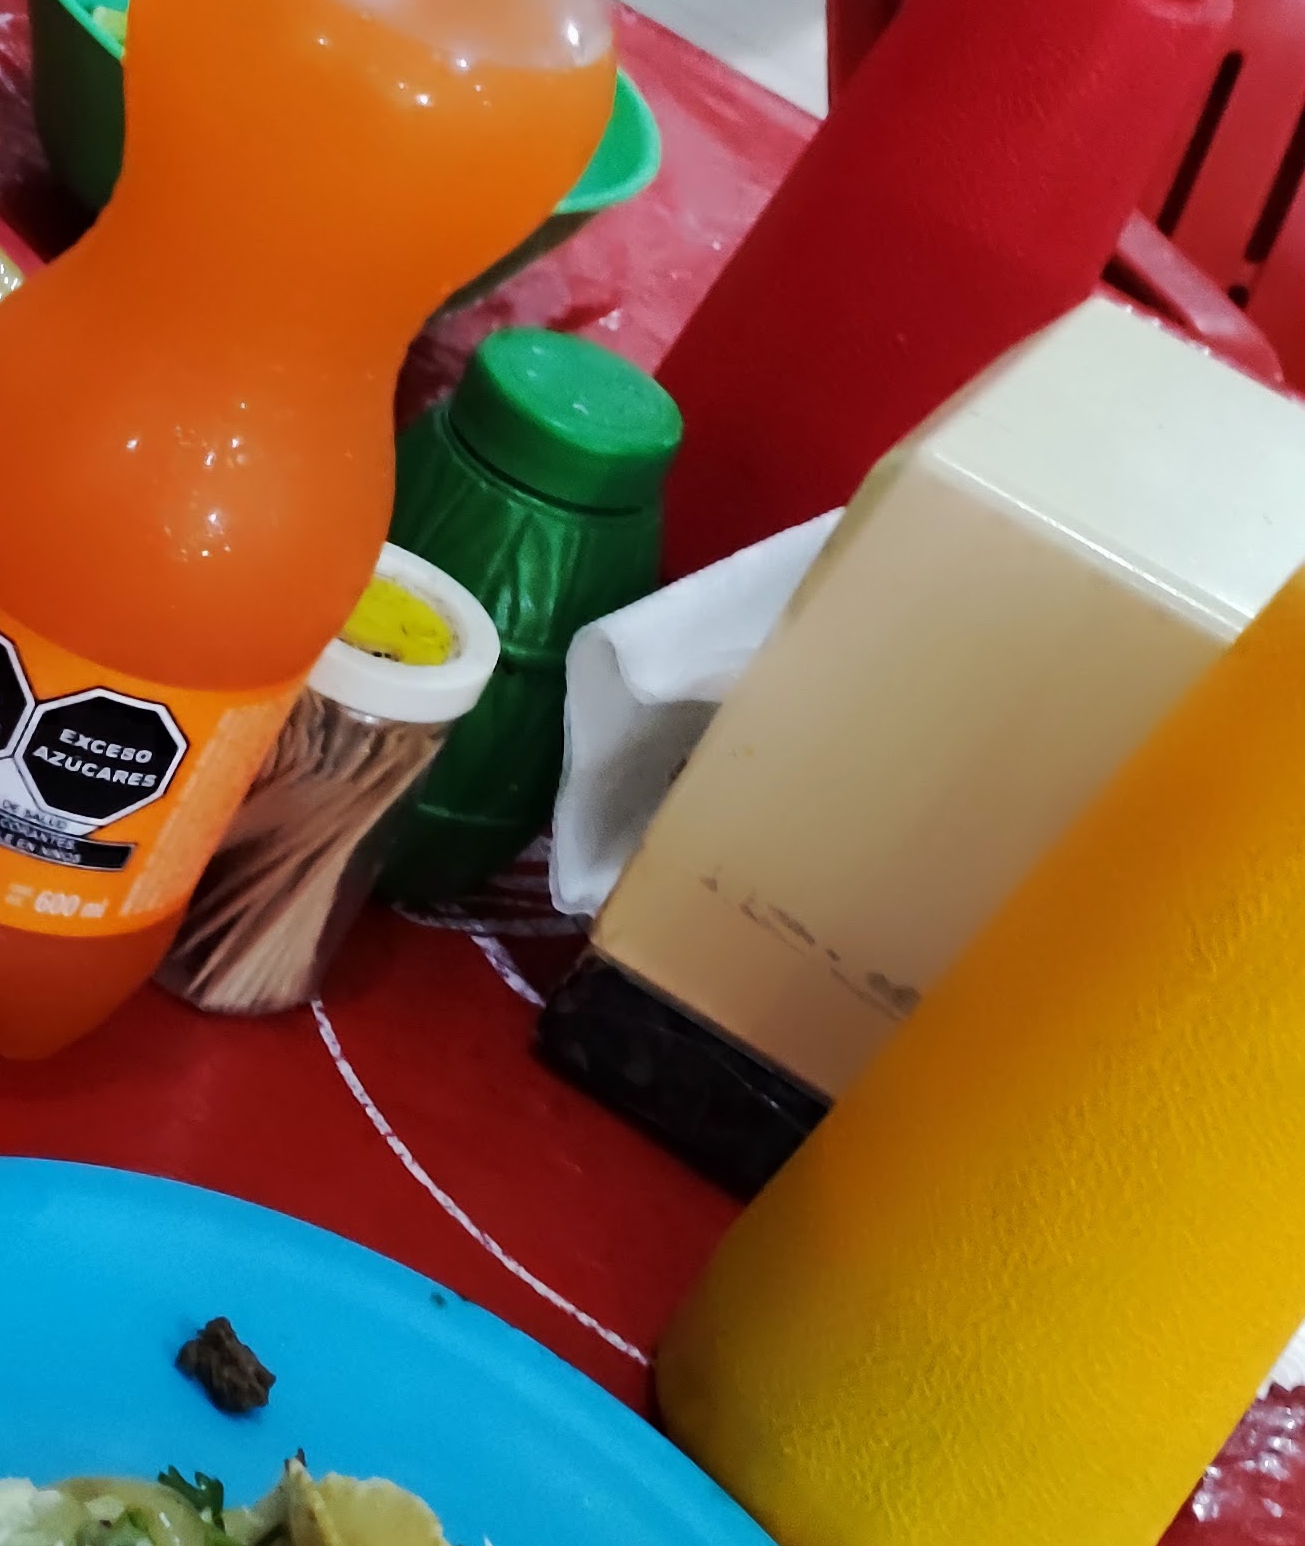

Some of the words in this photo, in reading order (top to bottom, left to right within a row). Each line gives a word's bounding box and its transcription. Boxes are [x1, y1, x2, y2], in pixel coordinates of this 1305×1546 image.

[58, 728, 153, 764] EXCESO
[23, 809, 68, 830] SALUD
[33, 890, 82, 917] 600
